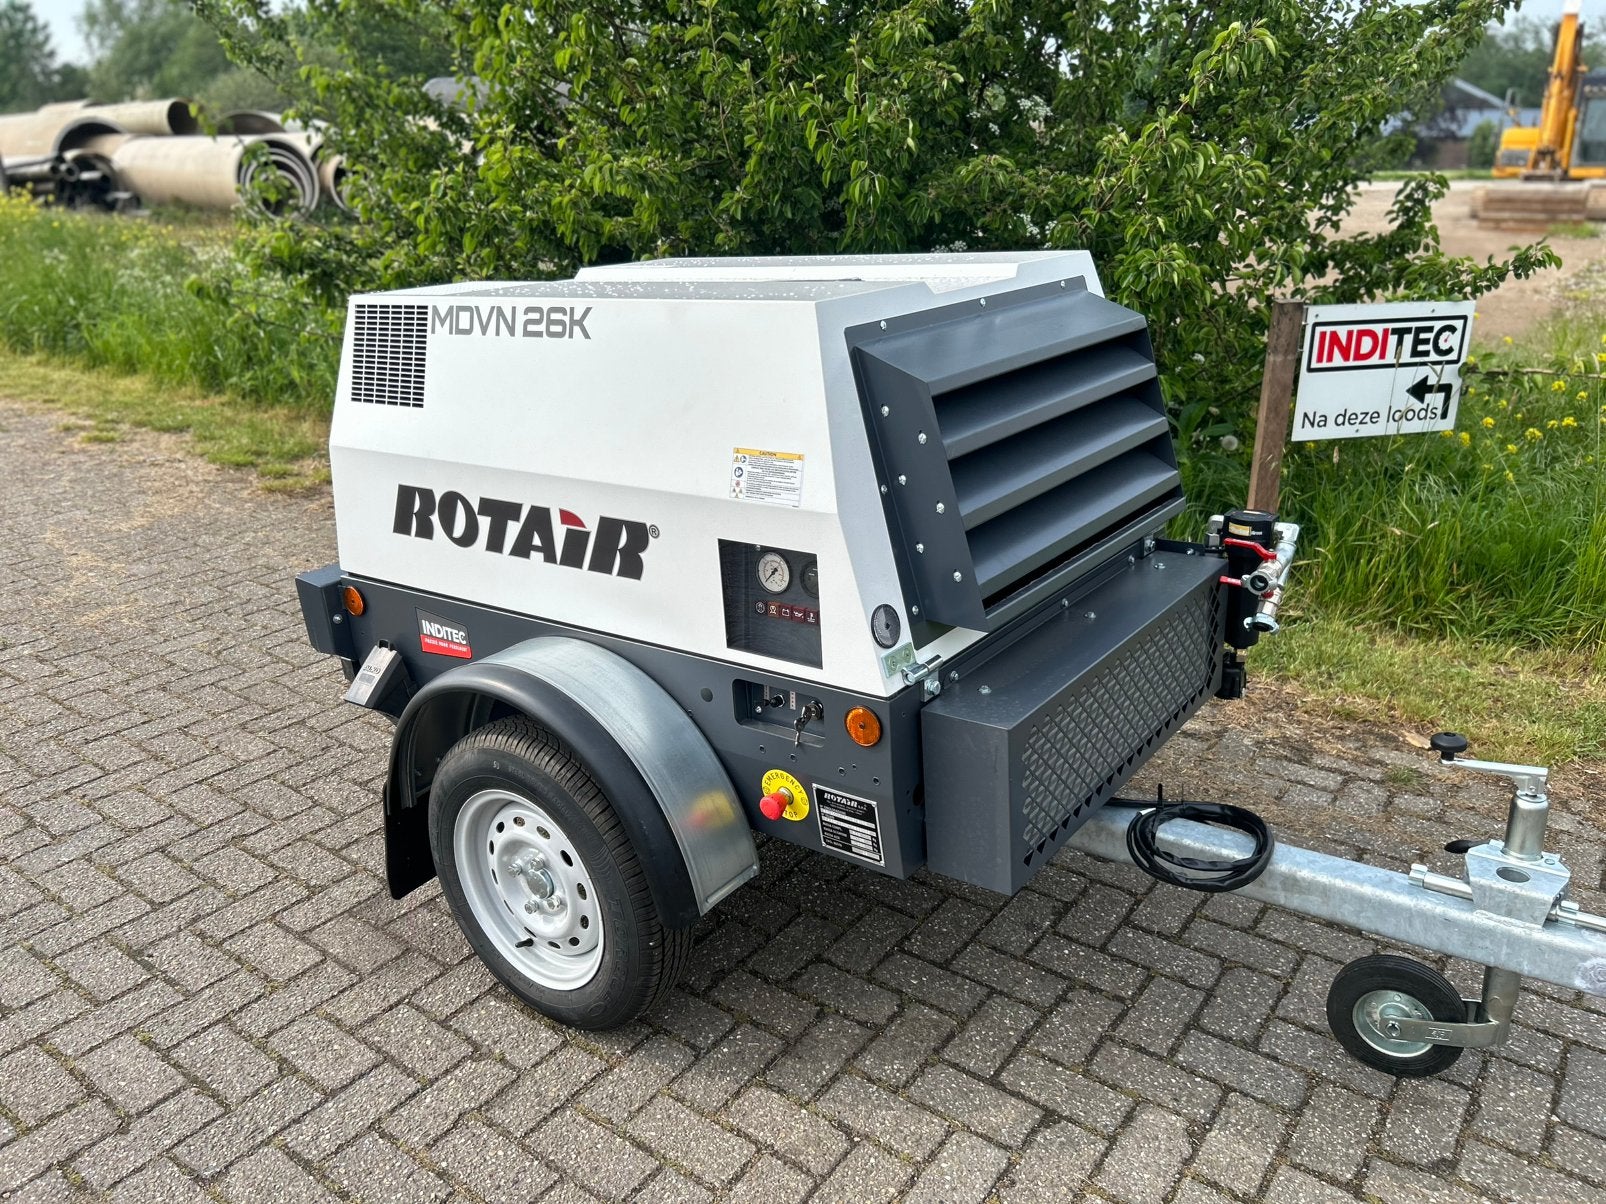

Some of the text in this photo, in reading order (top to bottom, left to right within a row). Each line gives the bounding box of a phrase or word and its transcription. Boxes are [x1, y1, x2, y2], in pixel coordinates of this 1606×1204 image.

[431, 305, 593, 340] MDVN 26K
[1315, 324, 1458, 364] INDITEC
[1301, 403, 1438, 429] Na deze loods
[421, 619, 467, 645] INDITEC
[764, 772, 805, 794] EMERGENCY
